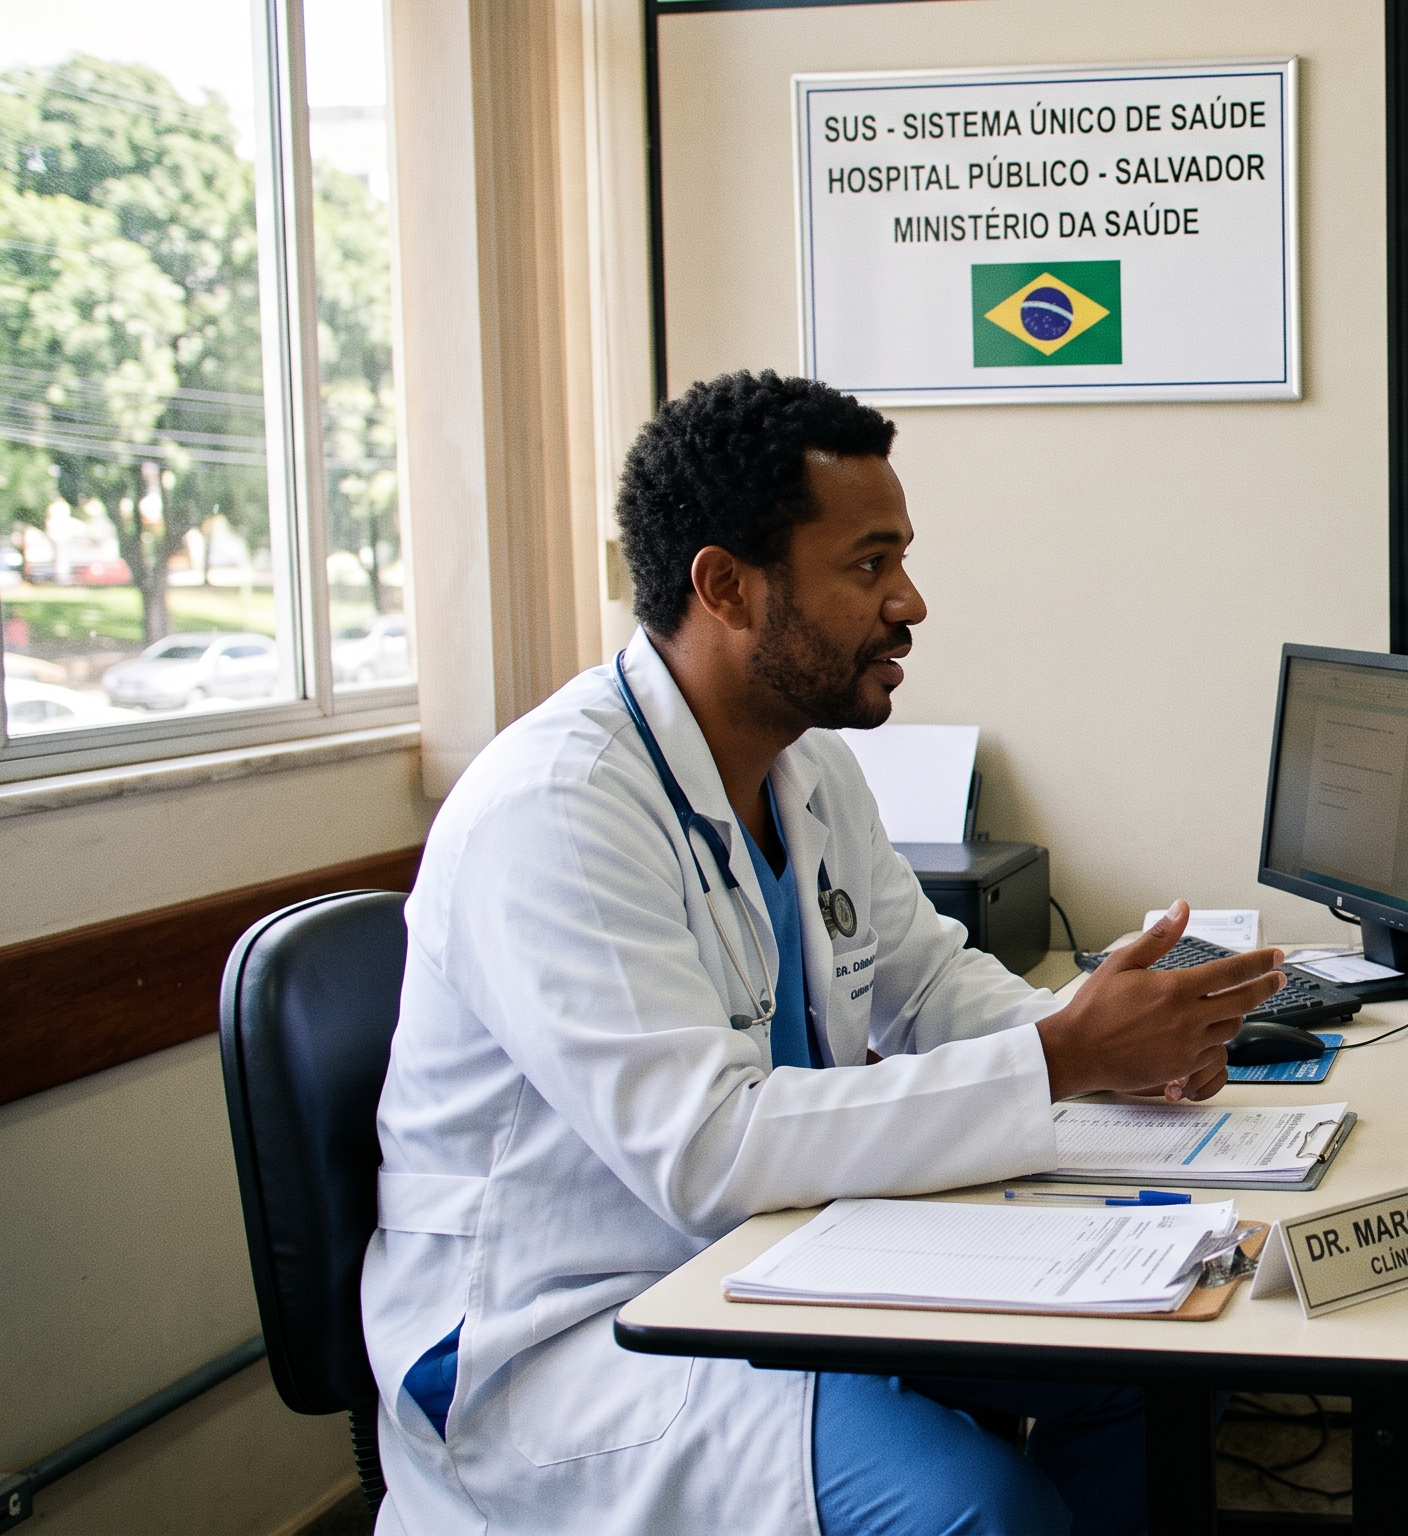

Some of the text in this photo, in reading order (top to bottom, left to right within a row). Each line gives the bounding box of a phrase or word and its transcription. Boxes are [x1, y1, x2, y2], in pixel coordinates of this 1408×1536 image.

[825, 114, 877, 143] SUS
[903, 110, 1022, 140] SISTEMA
[1030, 101, 1116, 136] ÚNICO
[1126, 104, 1162, 132] DE
[1171, 95, 1266, 131] SAÚDE
[828, 164, 960, 194] HOSPITAL
[968, 155, 1089, 189] PÚBLICO
[1115, 153, 1265, 185] SALVADOR
[894, 201, 1199, 243] MINISTÉRIO DA SAÚDE
[1305, 1229, 1350, 1262] DR.
